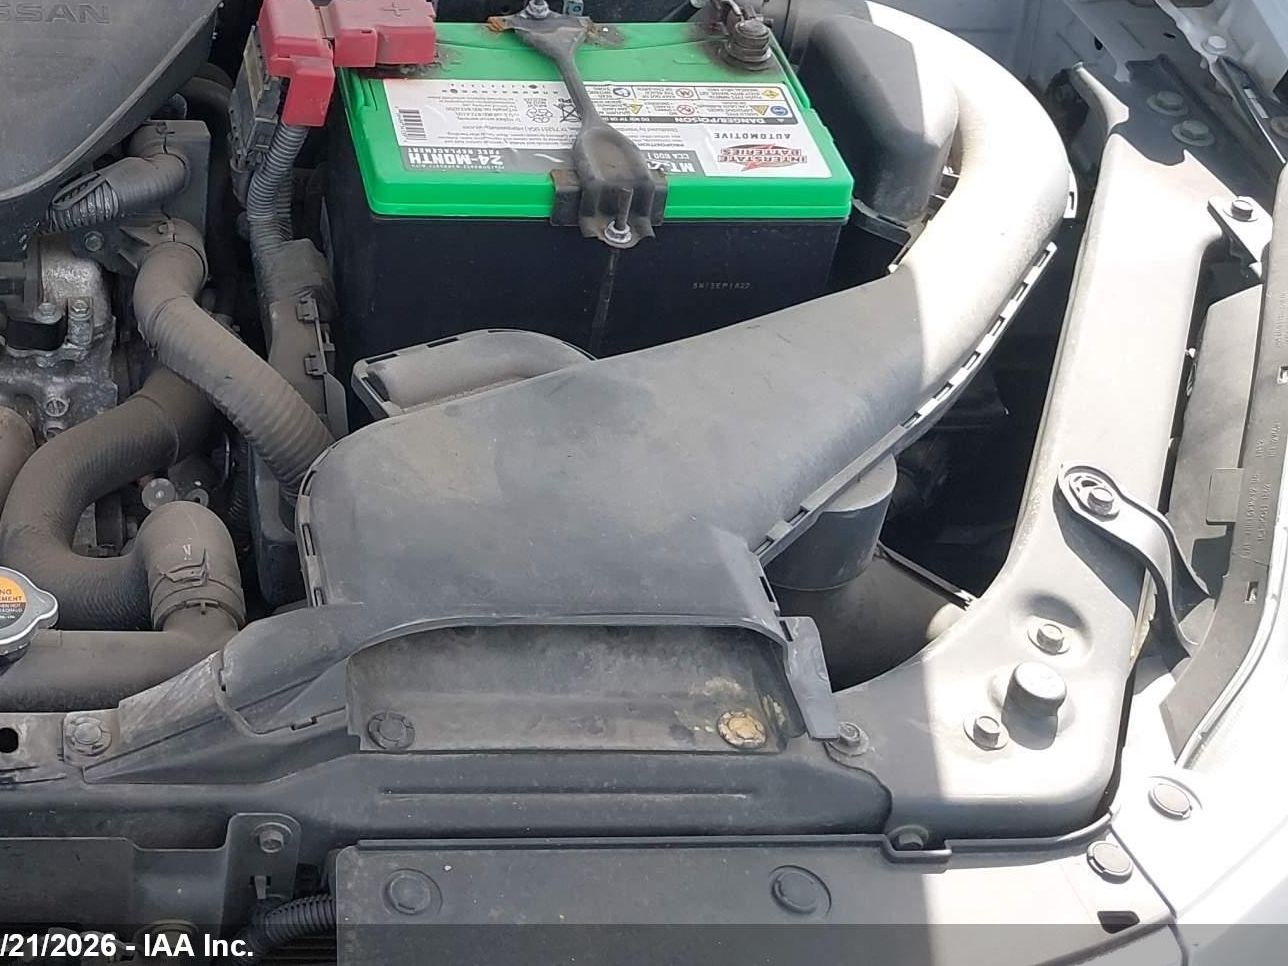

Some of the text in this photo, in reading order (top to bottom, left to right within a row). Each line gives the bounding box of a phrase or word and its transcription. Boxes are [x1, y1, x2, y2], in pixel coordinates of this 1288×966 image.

[713, 132, 791, 140] AUTOMOTIVE
[407, 147, 474, 155] REPLACEMENT
[720, 148, 802, 156] BATTERIES
[408, 152, 504, 165] 24-MONTH
[717, 155, 808, 164] INTERSTATE
